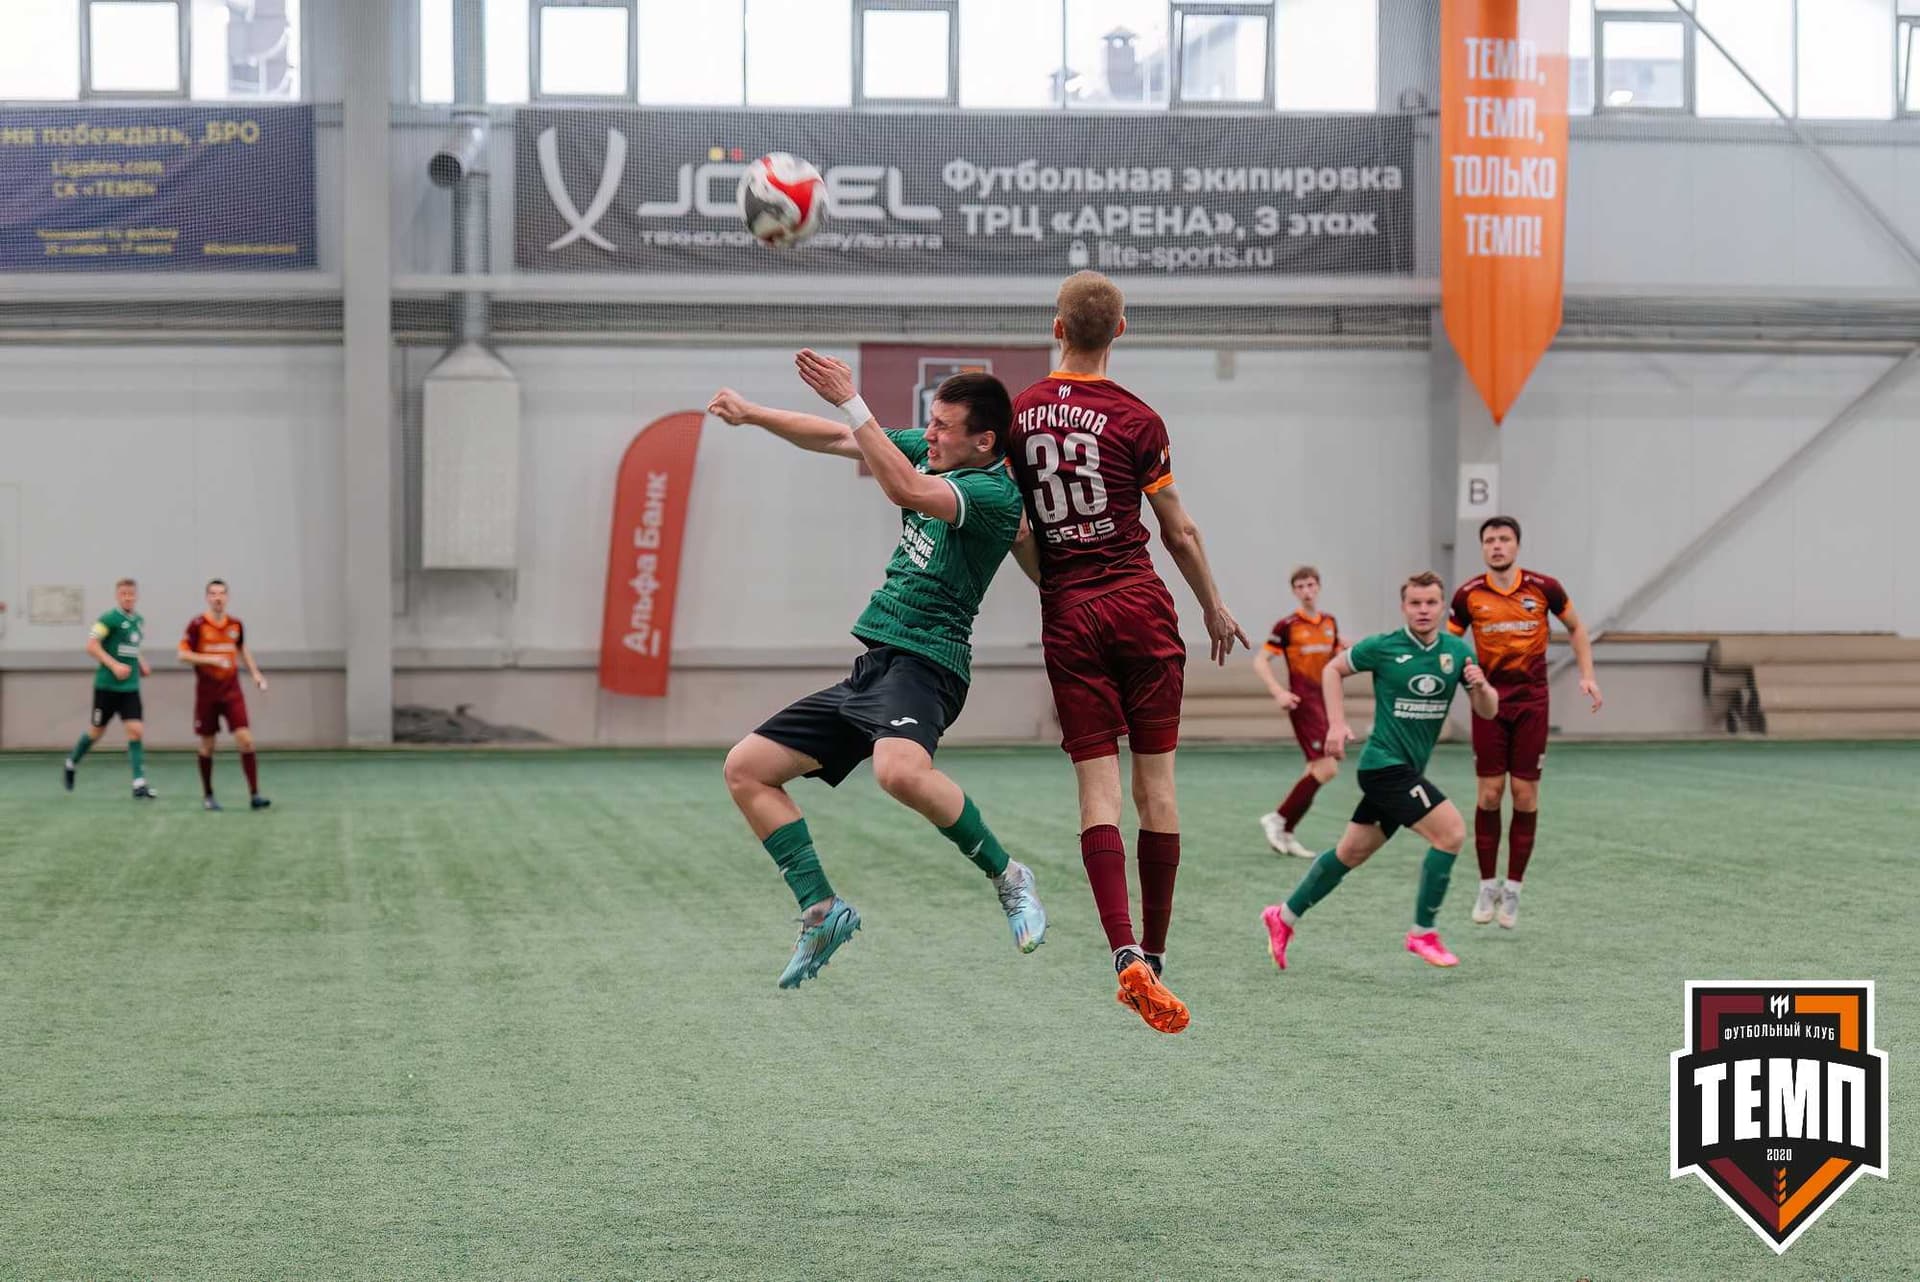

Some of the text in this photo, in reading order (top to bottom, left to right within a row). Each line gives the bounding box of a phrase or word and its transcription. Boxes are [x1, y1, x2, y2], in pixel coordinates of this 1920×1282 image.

[1464, 37, 1547, 87] ТЕМП,
[1464, 95, 1545, 145] ТЕМП,
[942, 158, 1402, 199] Футбольная экипировка
[1451, 154, 1558, 200] ТОЛЬКО
[960, 204, 1377, 241] ТРЦ «АРЕНА», 3 этаж
[1464, 213, 1543, 257] ТЕМП!
[1098, 242, 1275, 269] lite-sports.ru
[1018, 403, 1108, 436] ЧЕРКАСОВ
[1025, 432, 1108, 524] 33
[1470, 478, 1489, 506] B
[622, 471, 669, 656] Альфа Банк
[1408, 784, 1431, 809] 7
